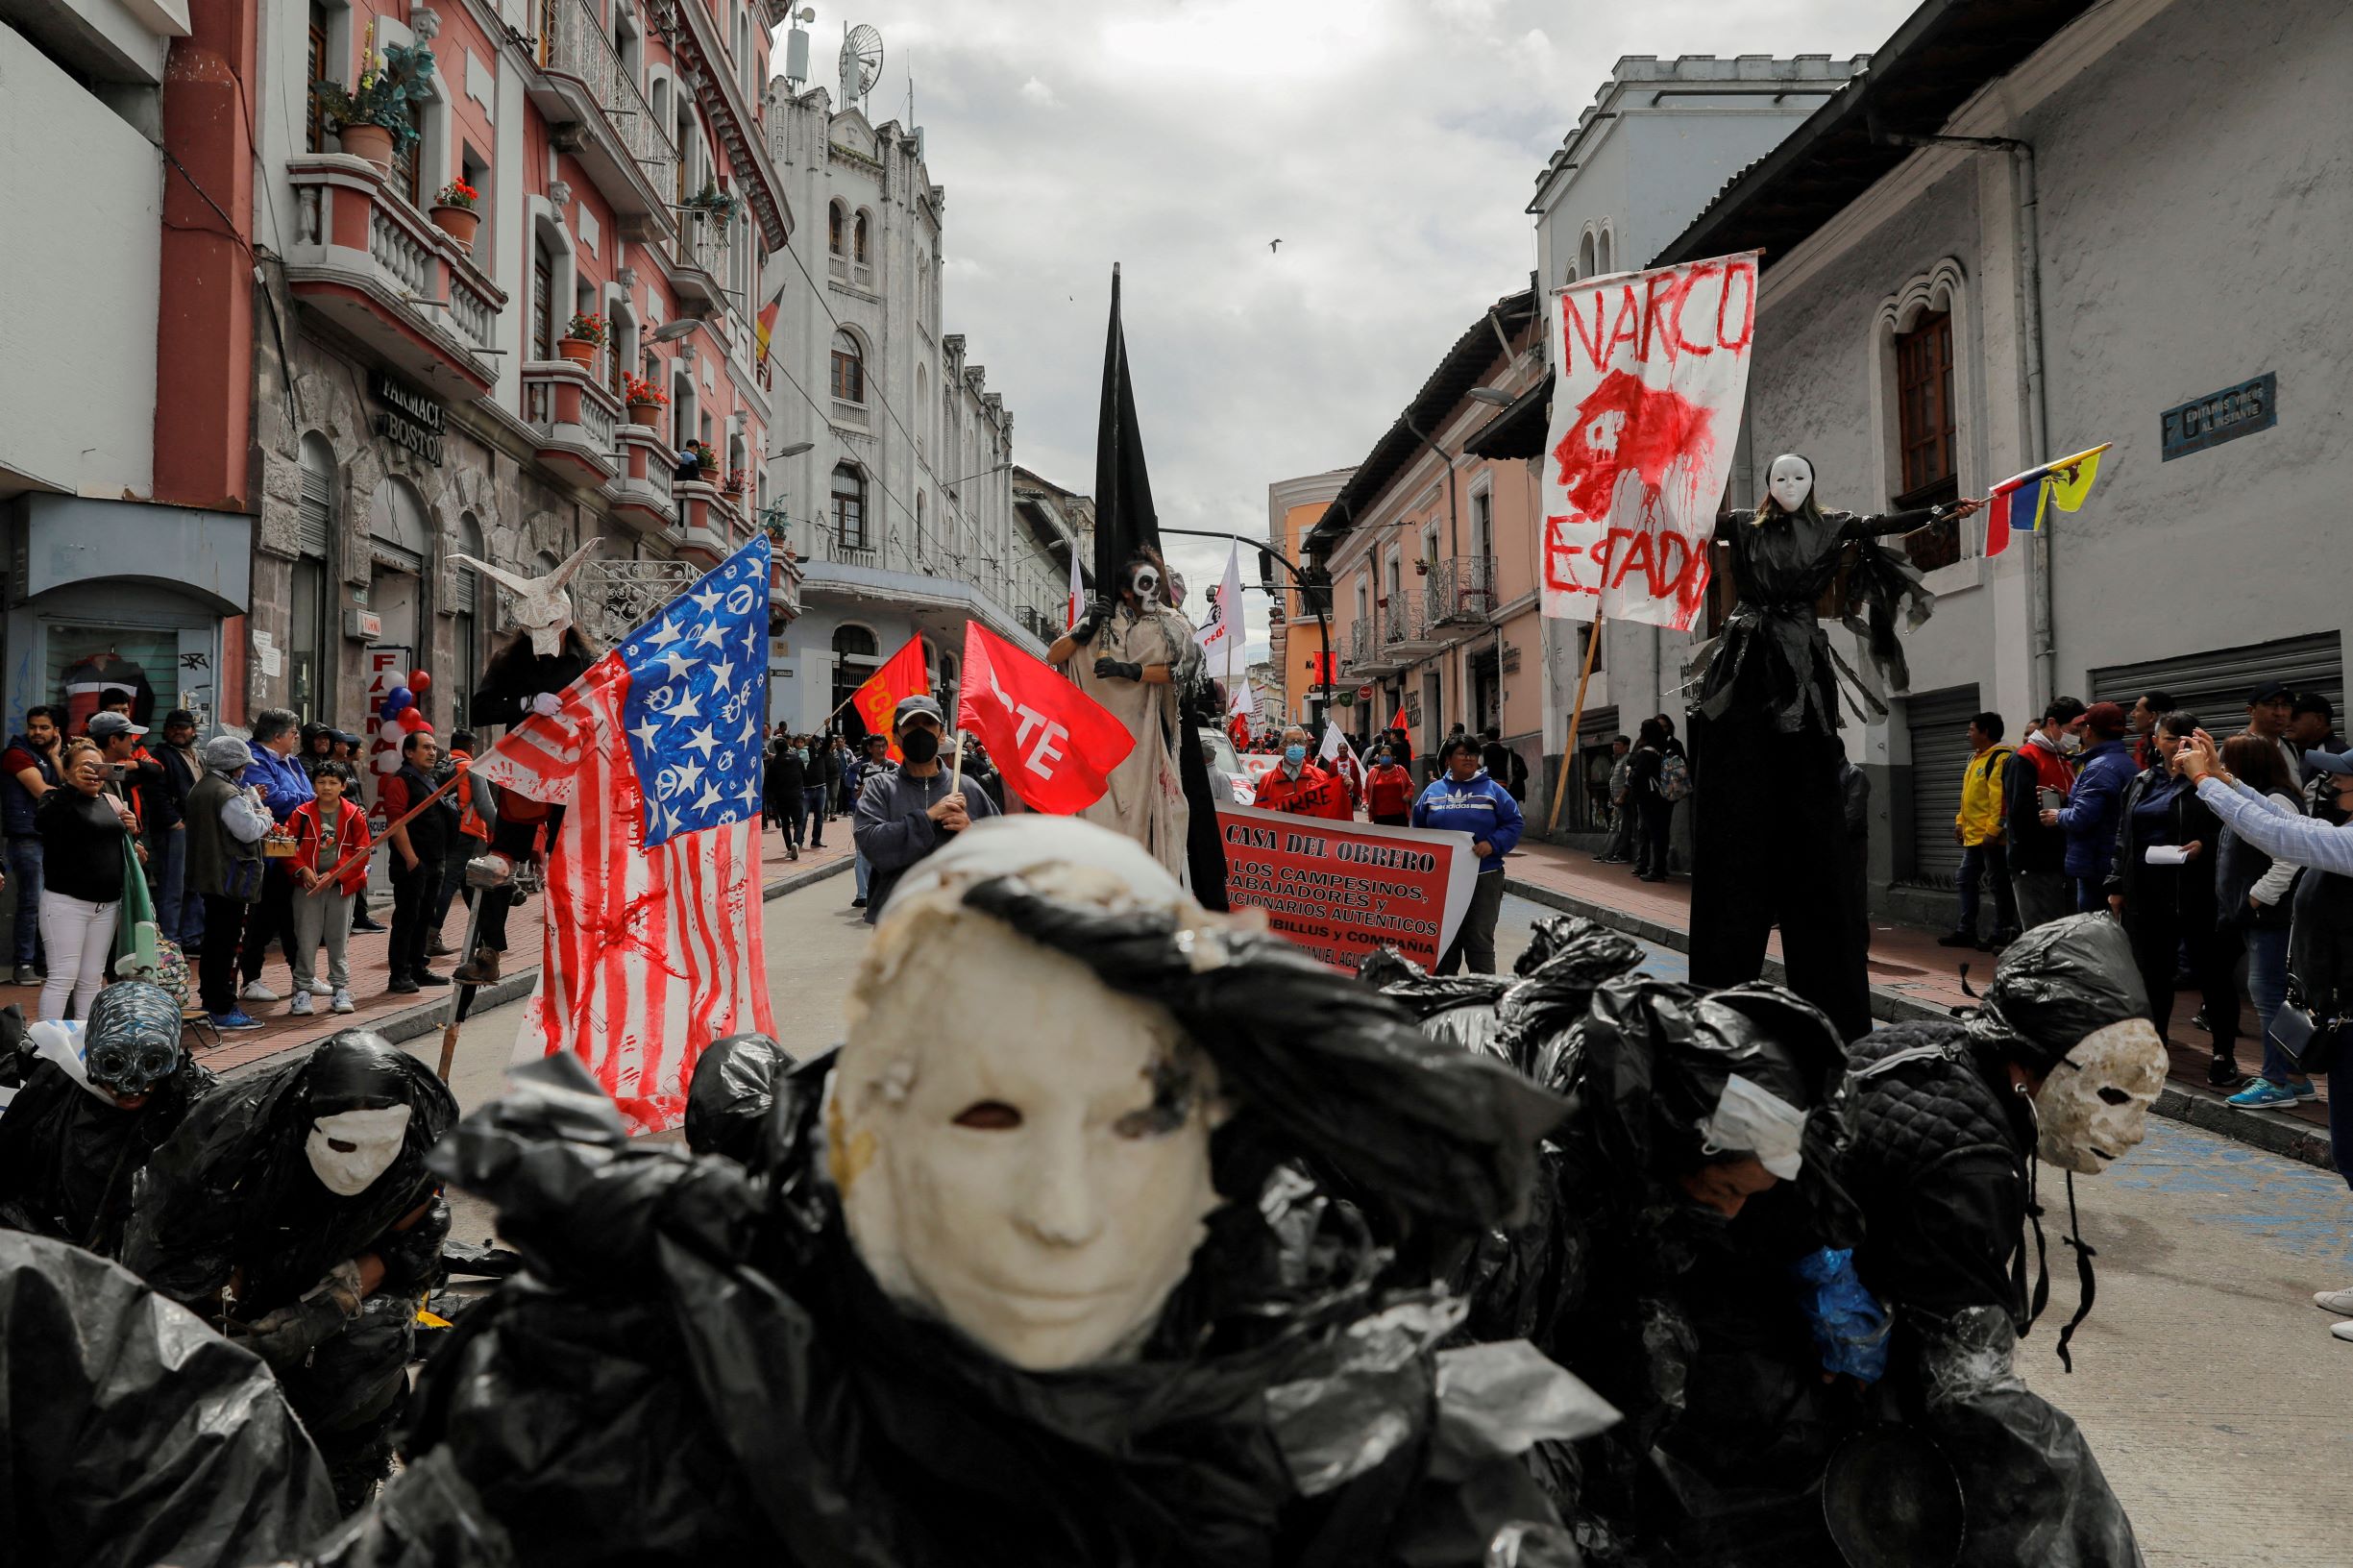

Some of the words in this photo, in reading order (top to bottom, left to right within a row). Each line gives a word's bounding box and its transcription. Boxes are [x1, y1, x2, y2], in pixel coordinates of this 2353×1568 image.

[1562, 261, 1754, 376] NARCO
[387, 411, 444, 465] BOSTON
[1226, 823, 1278, 850] CASA
[1286, 833, 1329, 859] DEL
[1336, 842, 1436, 874] OBRERO
[1234, 859, 1274, 877] LOS
[1280, 867, 1429, 904] CAMPESINOS,
[1330, 908, 1437, 937] AUTENTICOS
[1376, 899, 1388, 912] y
[1334, 930, 1342, 942] y
[1347, 930, 1435, 955] COMPAÑIA
